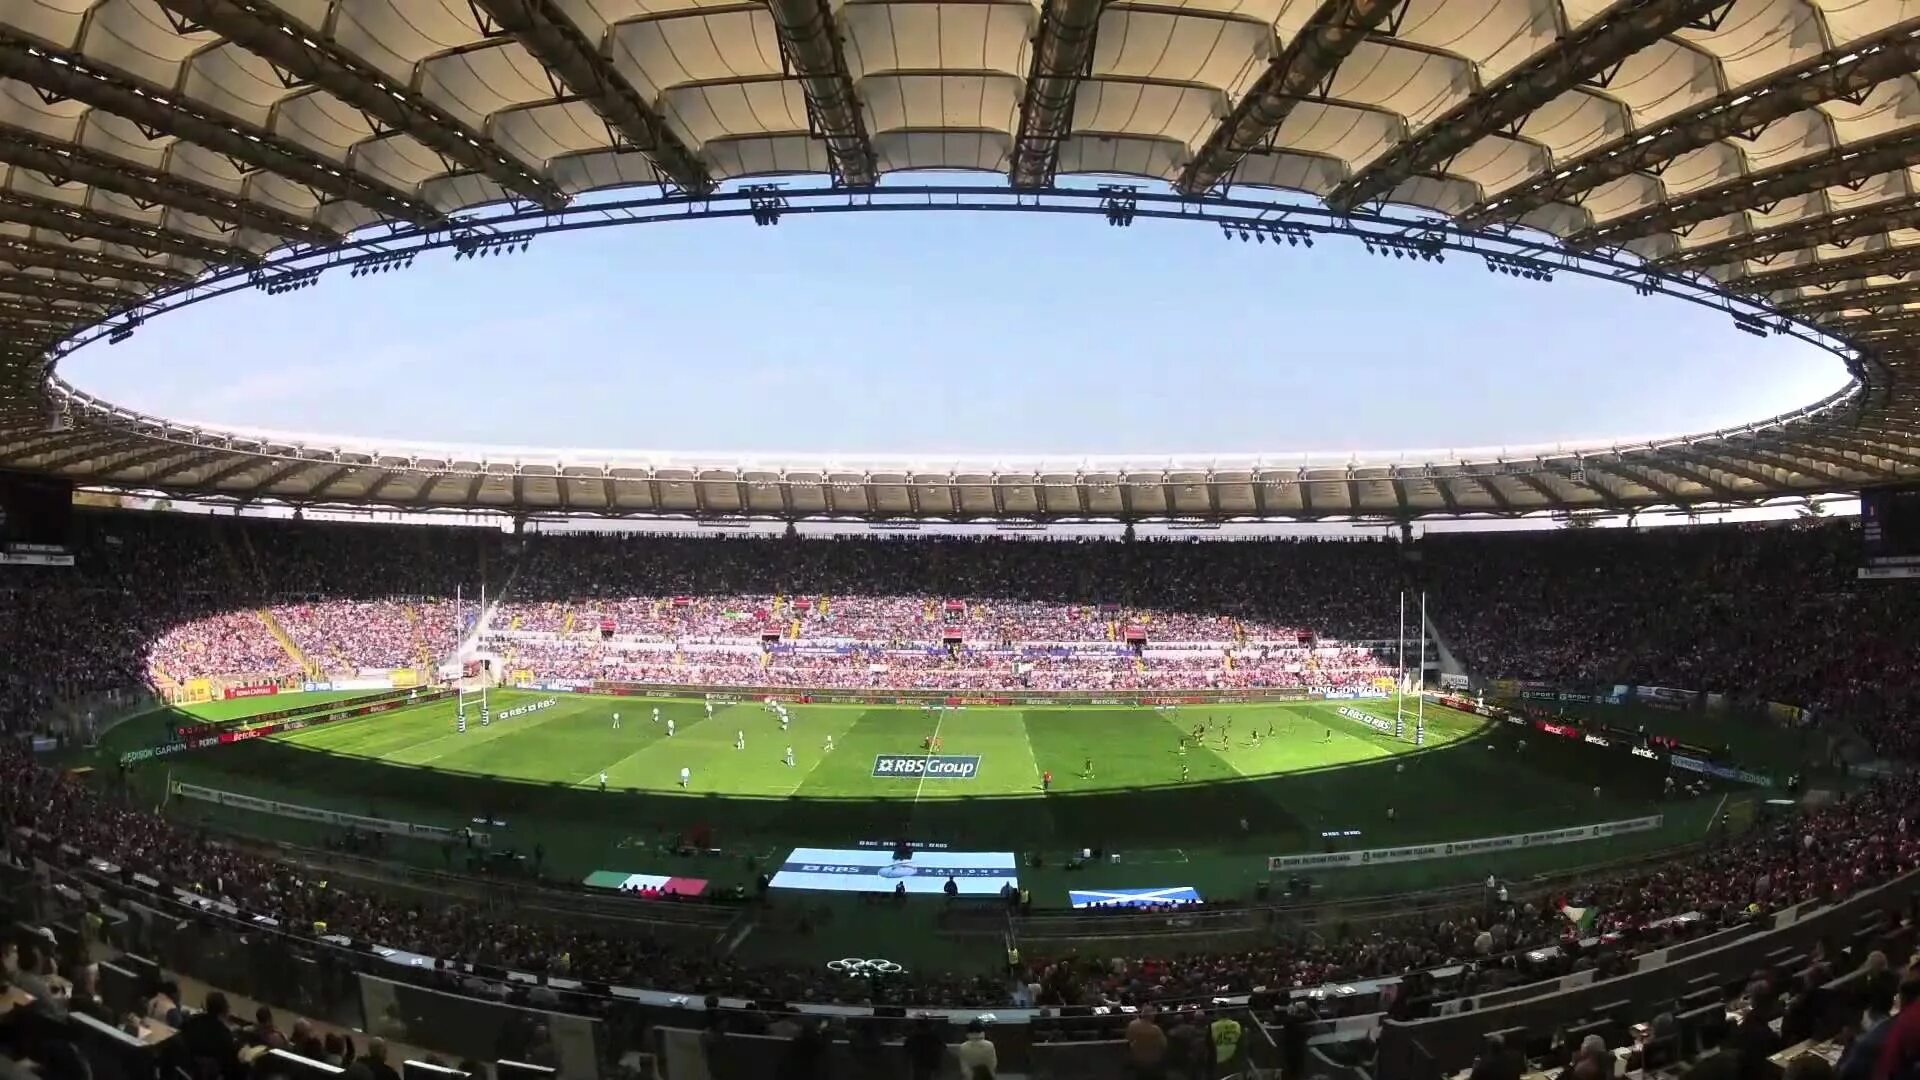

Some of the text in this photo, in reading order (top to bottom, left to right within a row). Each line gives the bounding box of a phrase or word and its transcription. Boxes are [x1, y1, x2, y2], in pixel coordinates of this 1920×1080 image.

[537, 698, 556, 710] RBS
[509, 705, 528, 717] RBS
[1347, 709, 1364, 721] RBS
[1372, 718, 1390, 730] RBS
[155, 743, 187, 757] GARMIN
[894, 759, 974, 777] RBS Group
